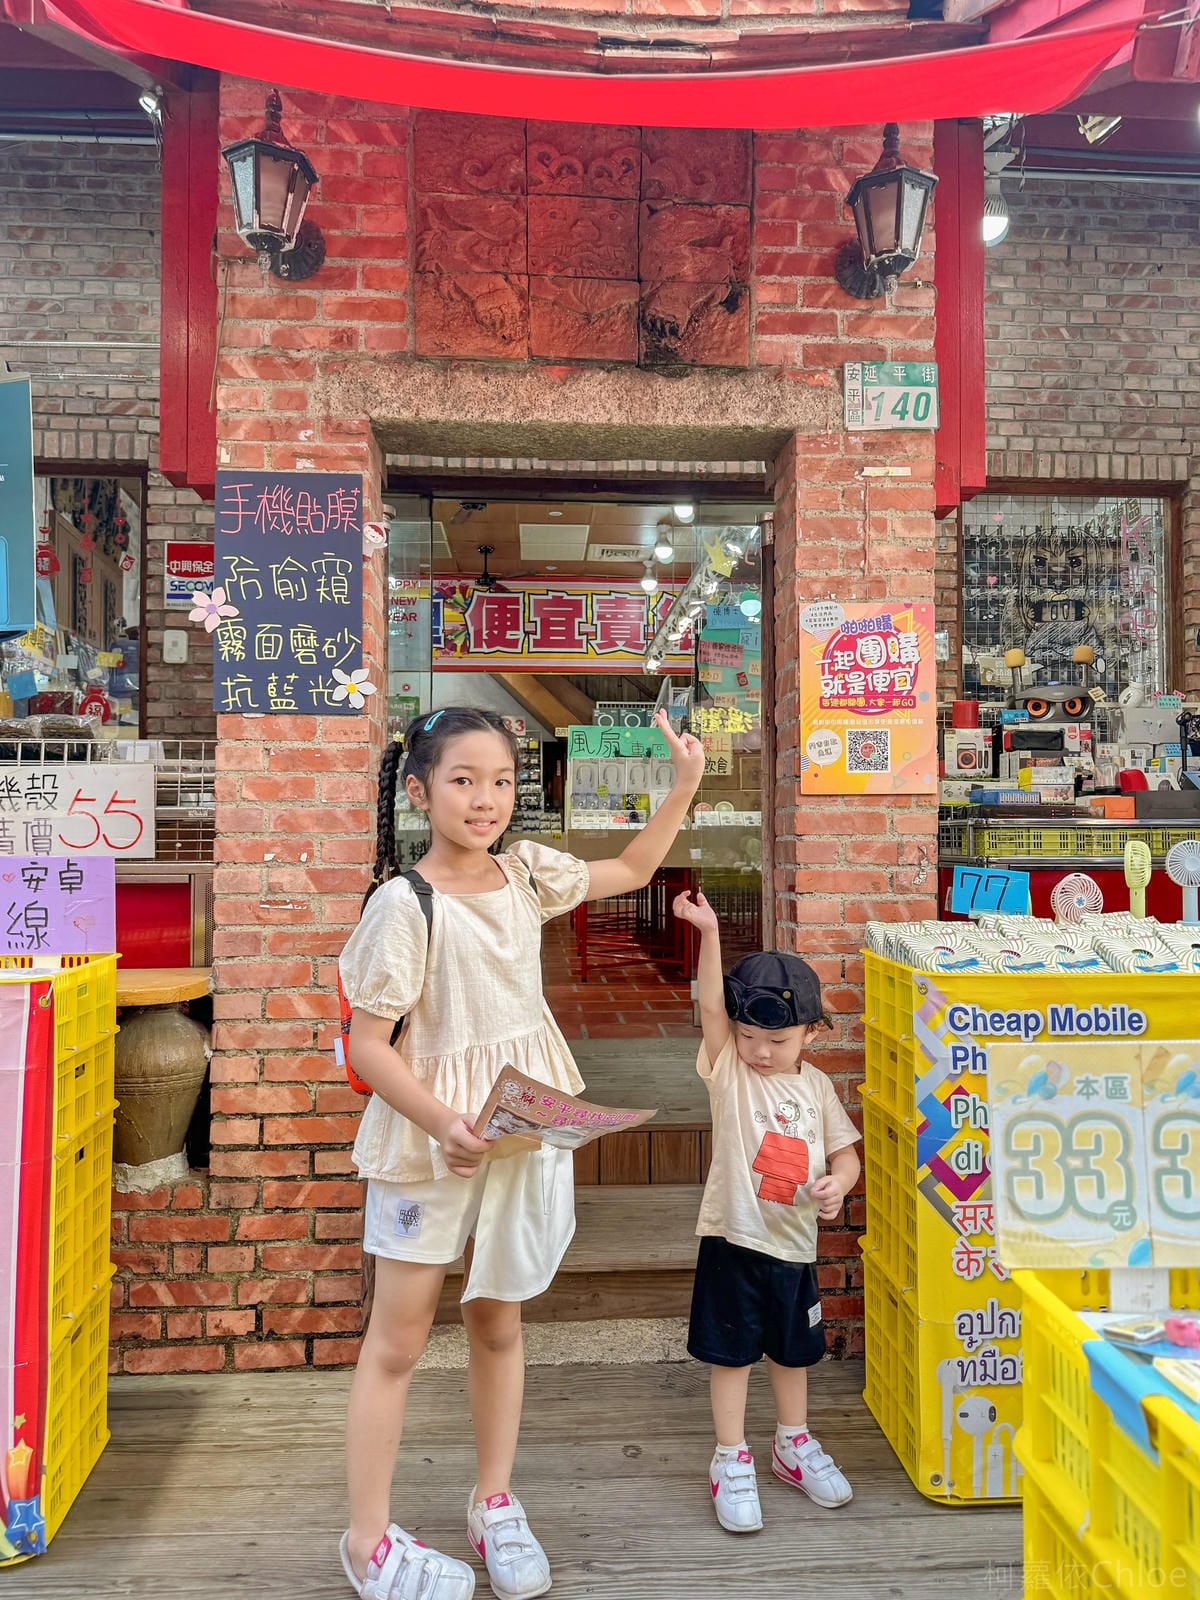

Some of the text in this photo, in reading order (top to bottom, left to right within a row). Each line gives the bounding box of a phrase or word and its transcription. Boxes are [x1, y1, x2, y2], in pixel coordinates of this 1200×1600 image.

[864, 365, 935, 384] 延平街
[847, 364, 861, 422] 安平區
[872, 391, 932, 421] 140
[220, 484, 361, 535] 手機貼膜
[169, 560, 214, 573] 中興保全
[222, 552, 353, 604] 防偷窺
[170, 581, 214, 592] SECOM
[391, 597, 417, 606] NEW
[466, 588, 694, 655] 便宜賣
[840, 614, 894, 635] 啪啪購
[216, 619, 361, 667] 霧面磨砂
[815, 632, 921, 672] 一起團購
[819, 666, 914, 699] 就是便宜
[88, 703, 104, 717] 福
[702, 736, 729, 753] 禁止
[59, 788, 144, 849] 55
[21, 859, 84, 894] 安卓
[960, 872, 1010, 910] 77
[7, 901, 51, 950] 線
[949, 1005, 1144, 1039] Cheap Mobile
[1075, 1075, 1130, 1101] 本區
[1003, 1110, 1136, 1228] 33 元
